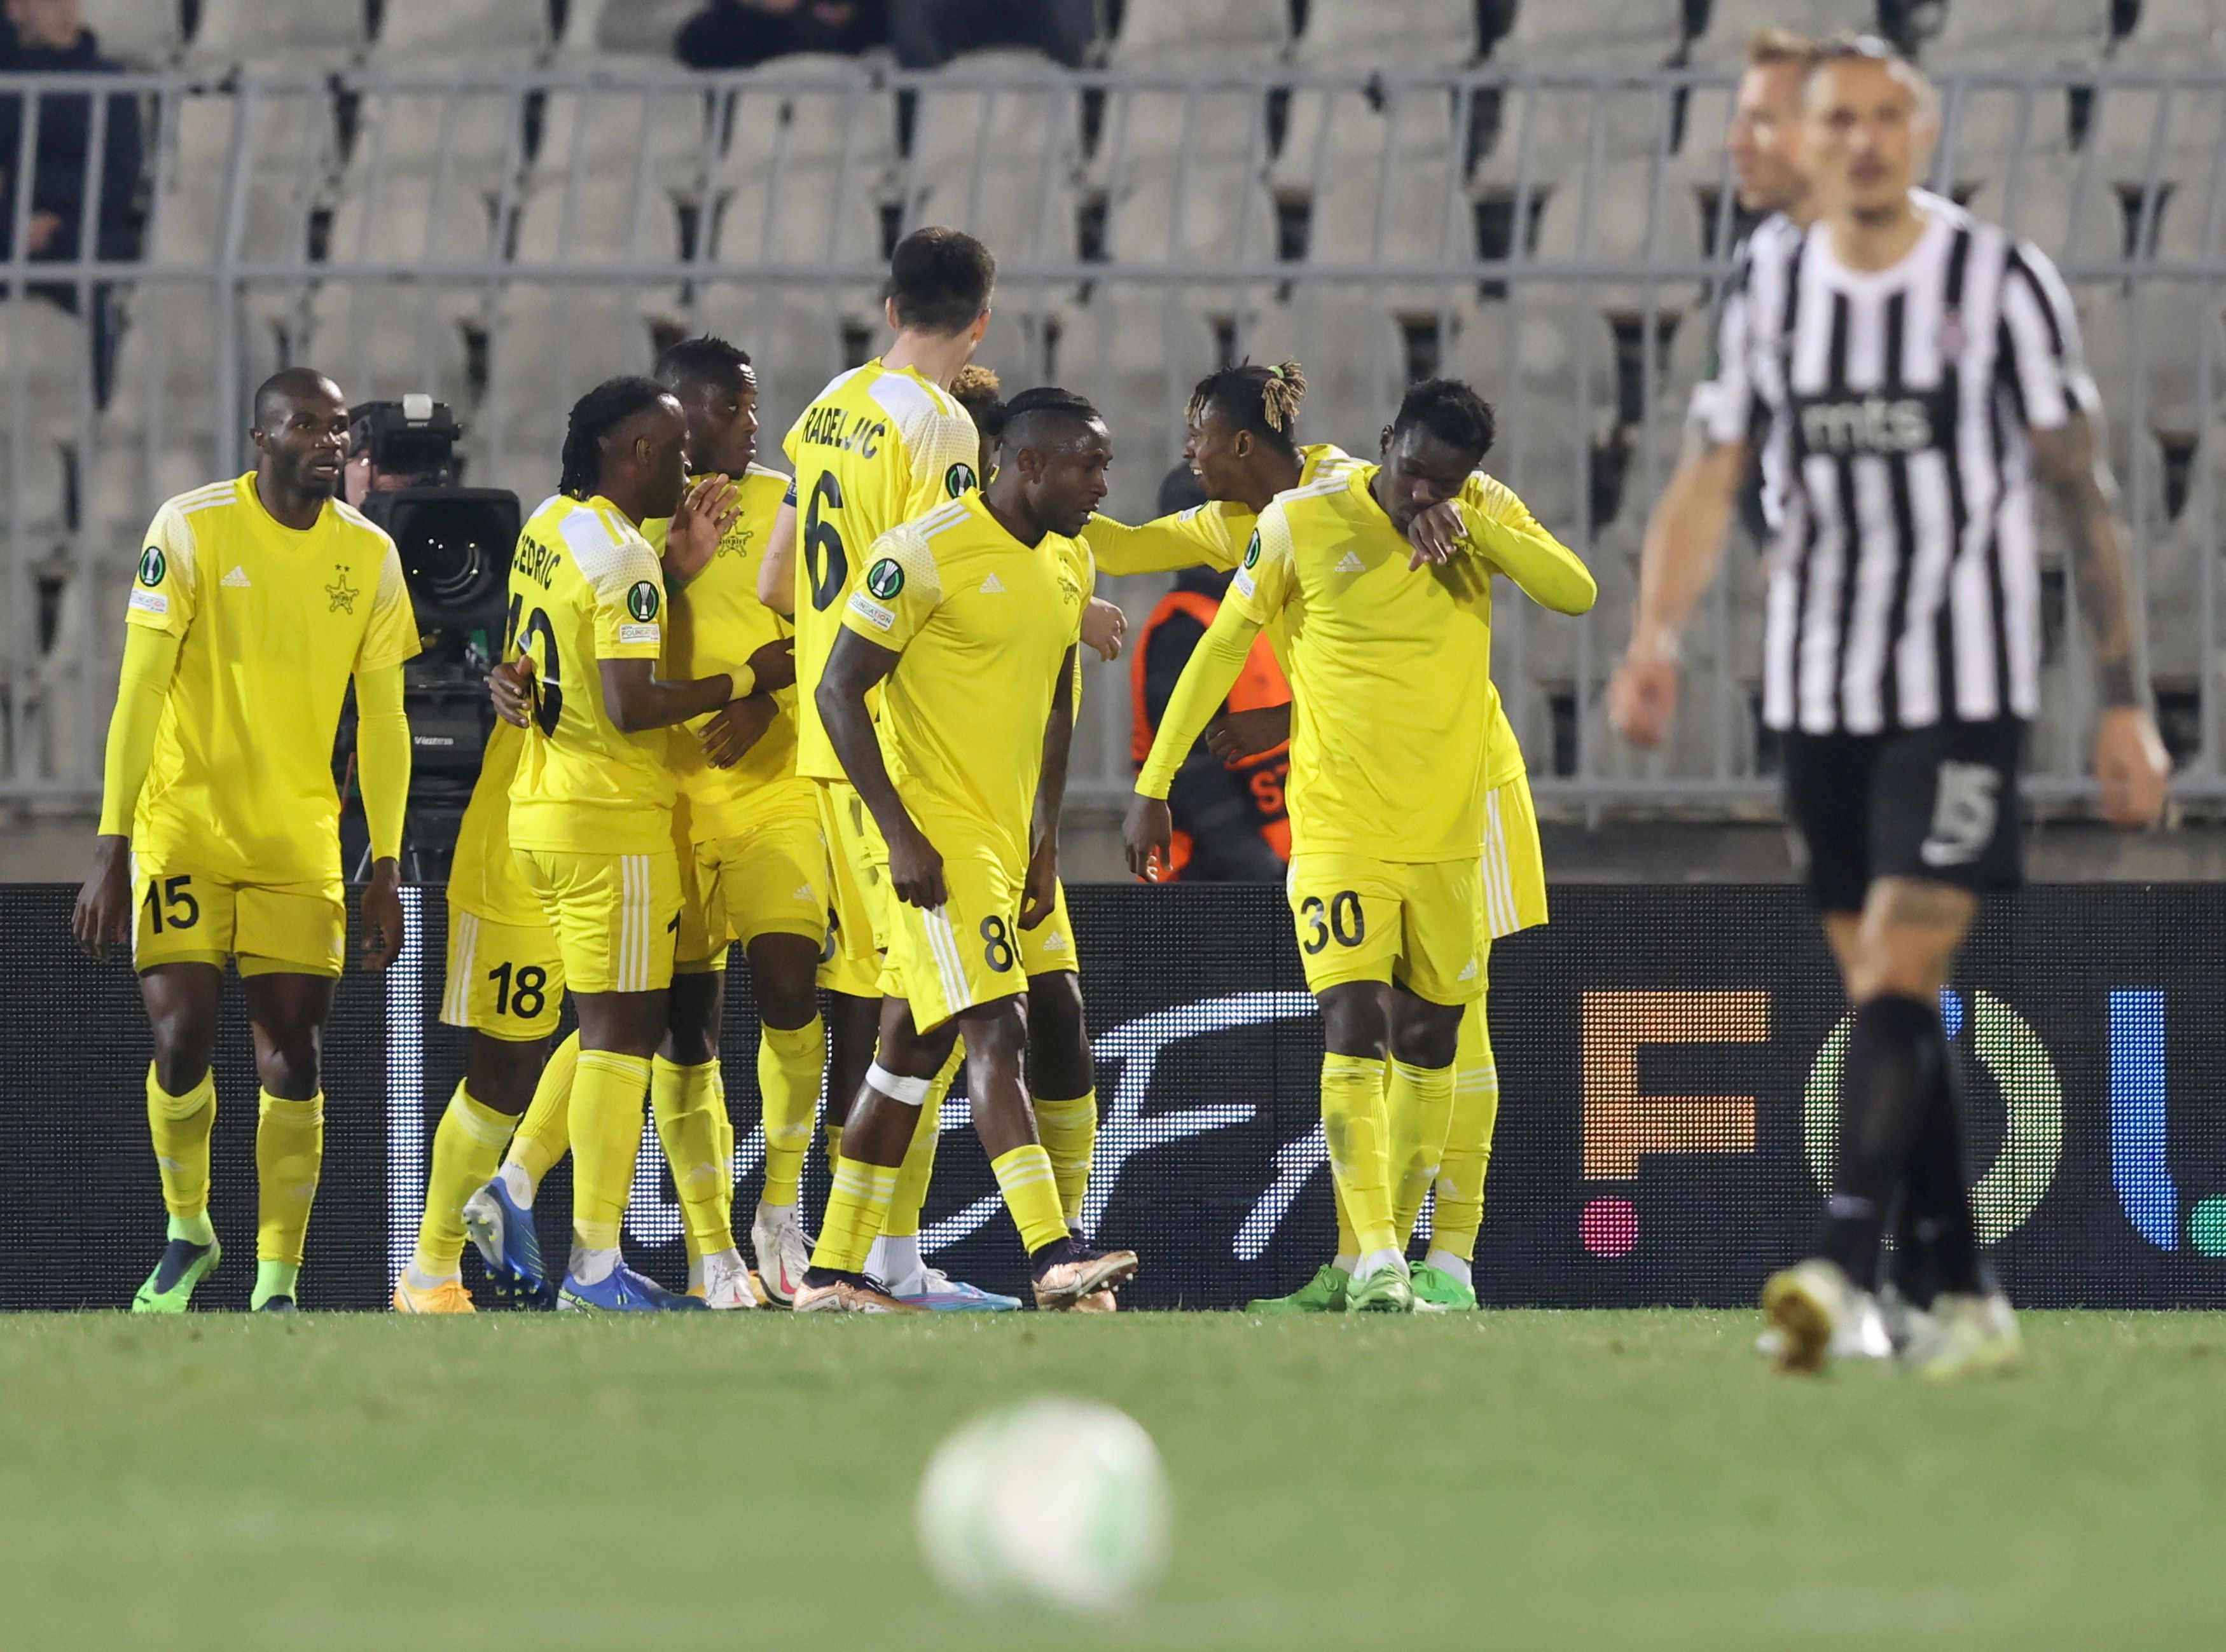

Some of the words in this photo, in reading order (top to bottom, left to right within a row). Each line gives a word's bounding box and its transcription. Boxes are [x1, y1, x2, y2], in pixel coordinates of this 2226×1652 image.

[801, 407, 887, 460] RADELJIĆ
[1799, 396, 1933, 455] mts
[511, 533, 561, 591] CEDRIC
[804, 469, 848, 612] 6
[1931, 759, 2002, 852] 15
[142, 874, 200, 935] 15
[1300, 890, 1365, 955] 30
[488, 962, 546, 1019] 18
